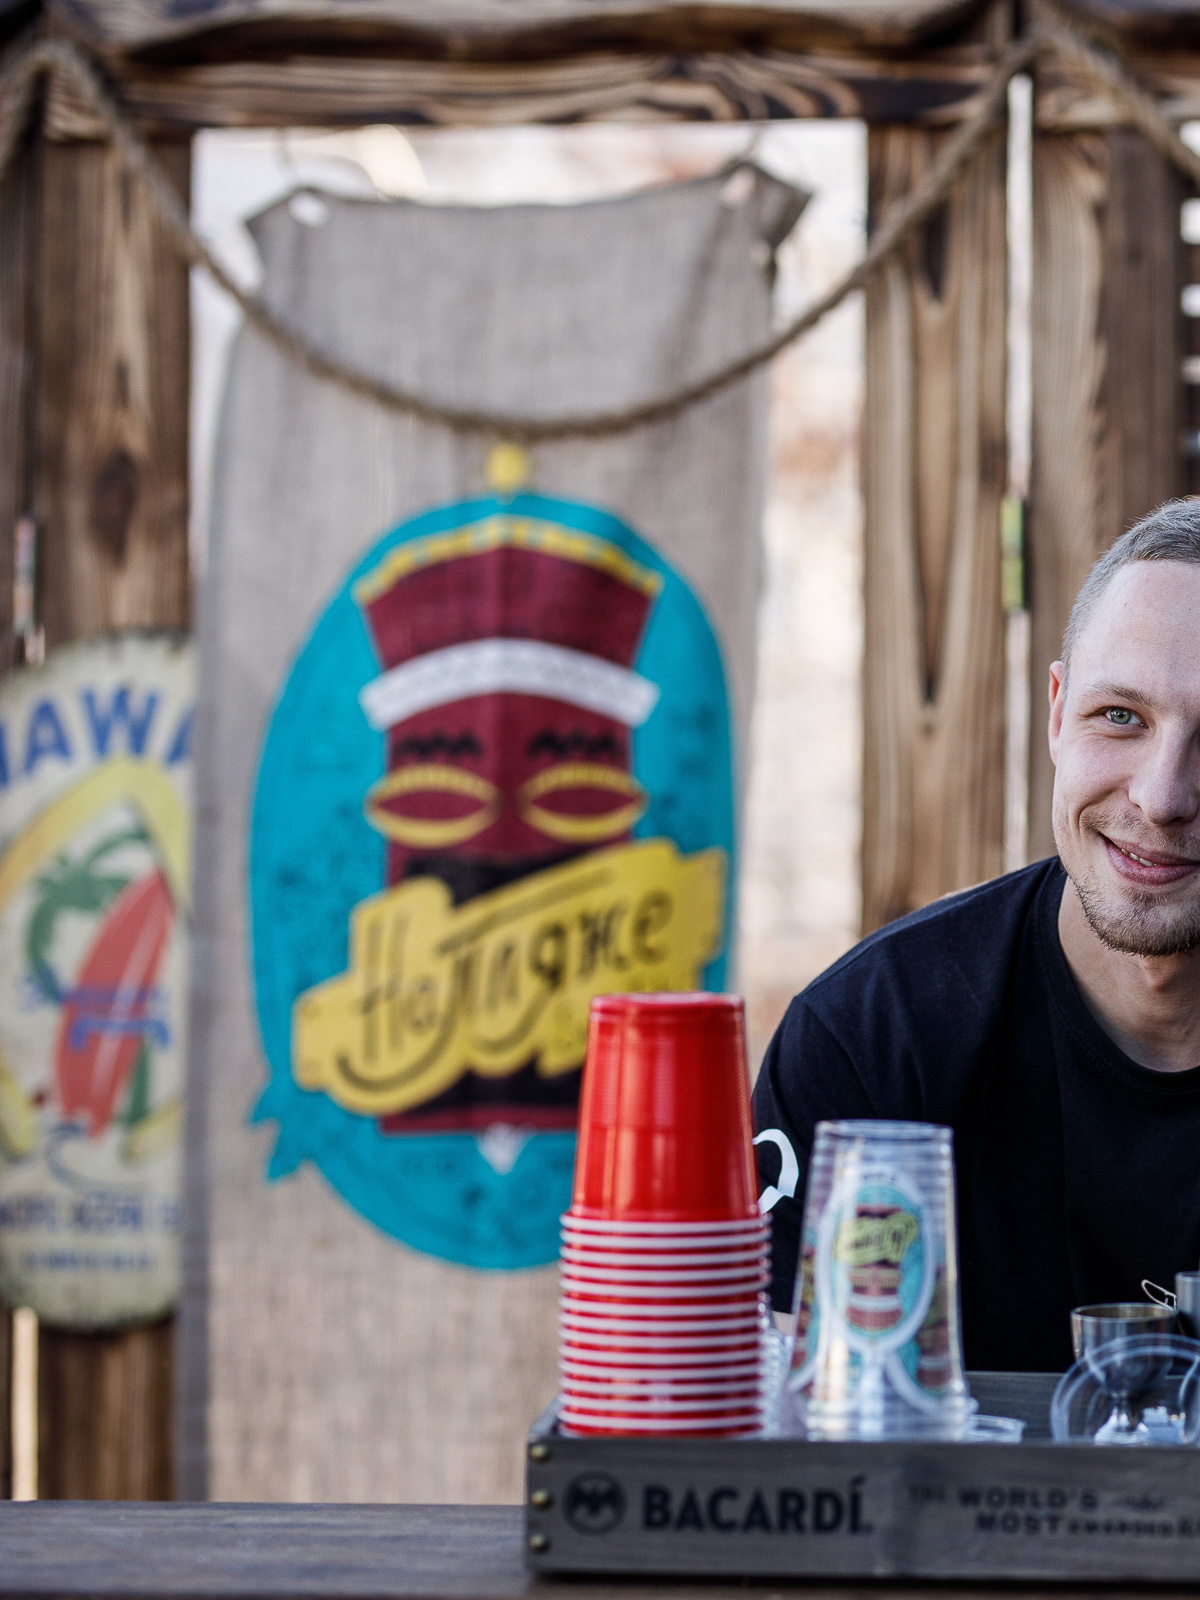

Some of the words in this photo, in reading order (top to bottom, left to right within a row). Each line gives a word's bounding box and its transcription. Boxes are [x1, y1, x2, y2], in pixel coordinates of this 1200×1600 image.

[641, 1474, 868, 1535] BACARDÍ
[957, 1485, 1098, 1511] WORLD'S
[975, 1512, 1061, 1535] MOST
